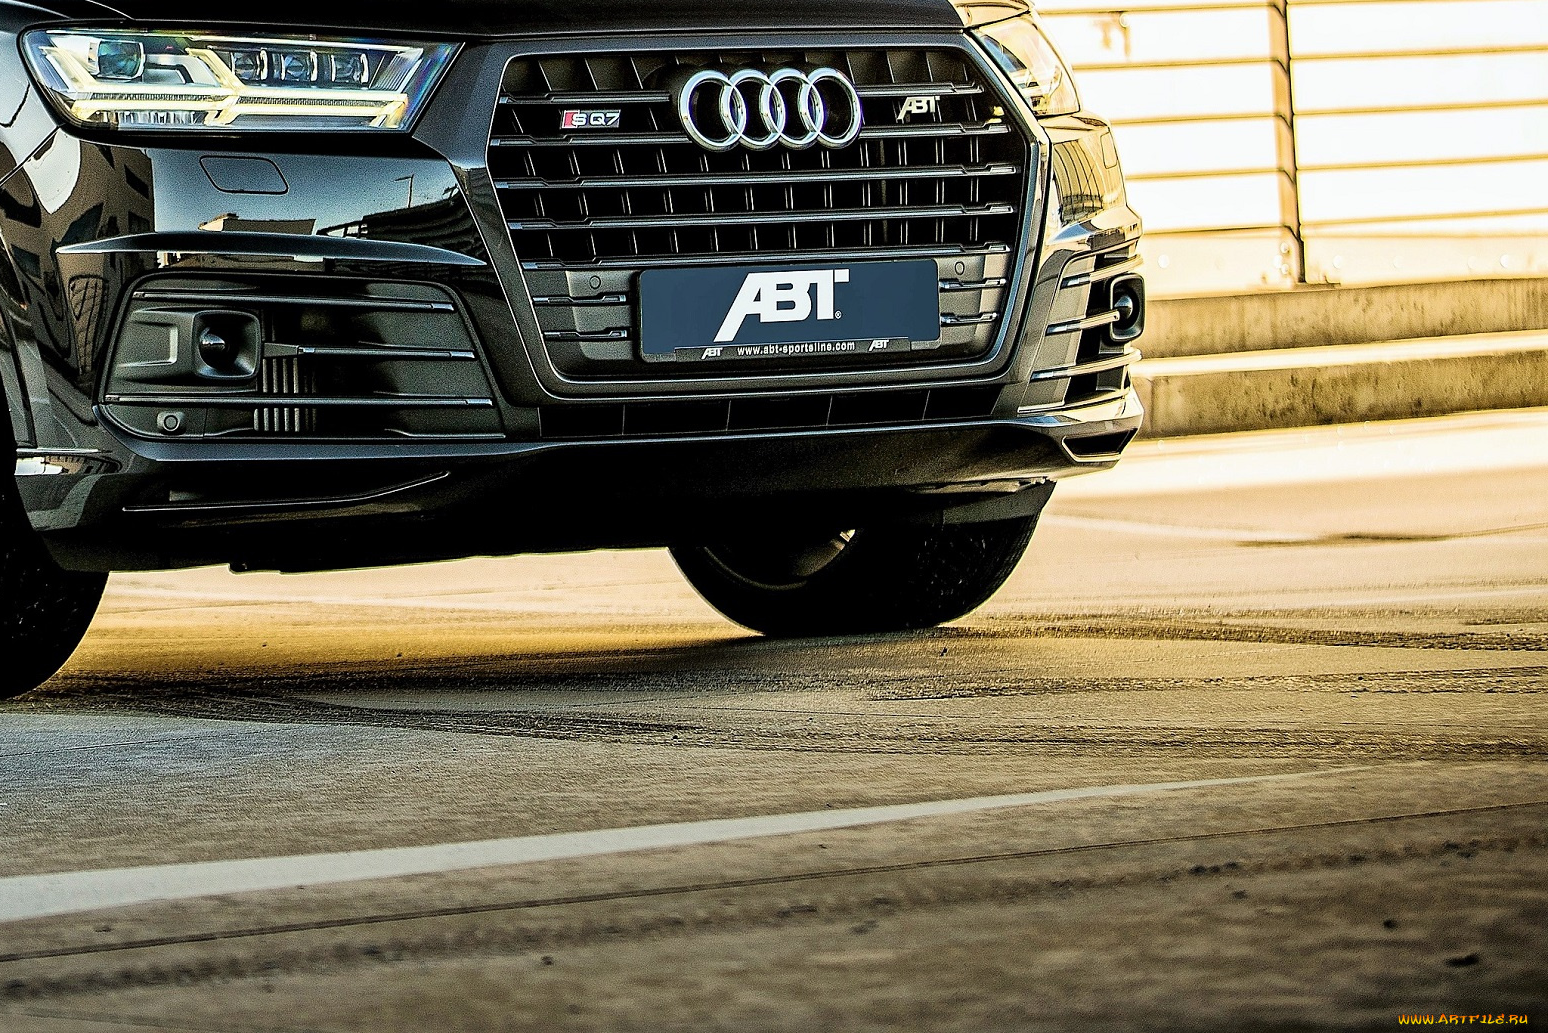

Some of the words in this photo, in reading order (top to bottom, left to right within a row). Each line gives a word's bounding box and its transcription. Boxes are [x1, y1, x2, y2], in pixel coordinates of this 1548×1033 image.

[571, 112, 620, 126] SQ7
[896, 96, 941, 121] ABT
[713, 269, 850, 342] ABT
[701, 347, 724, 360] ABT
[737, 341, 856, 356] www.abt-sportsline.com
[868, 339, 890, 352] ABT
